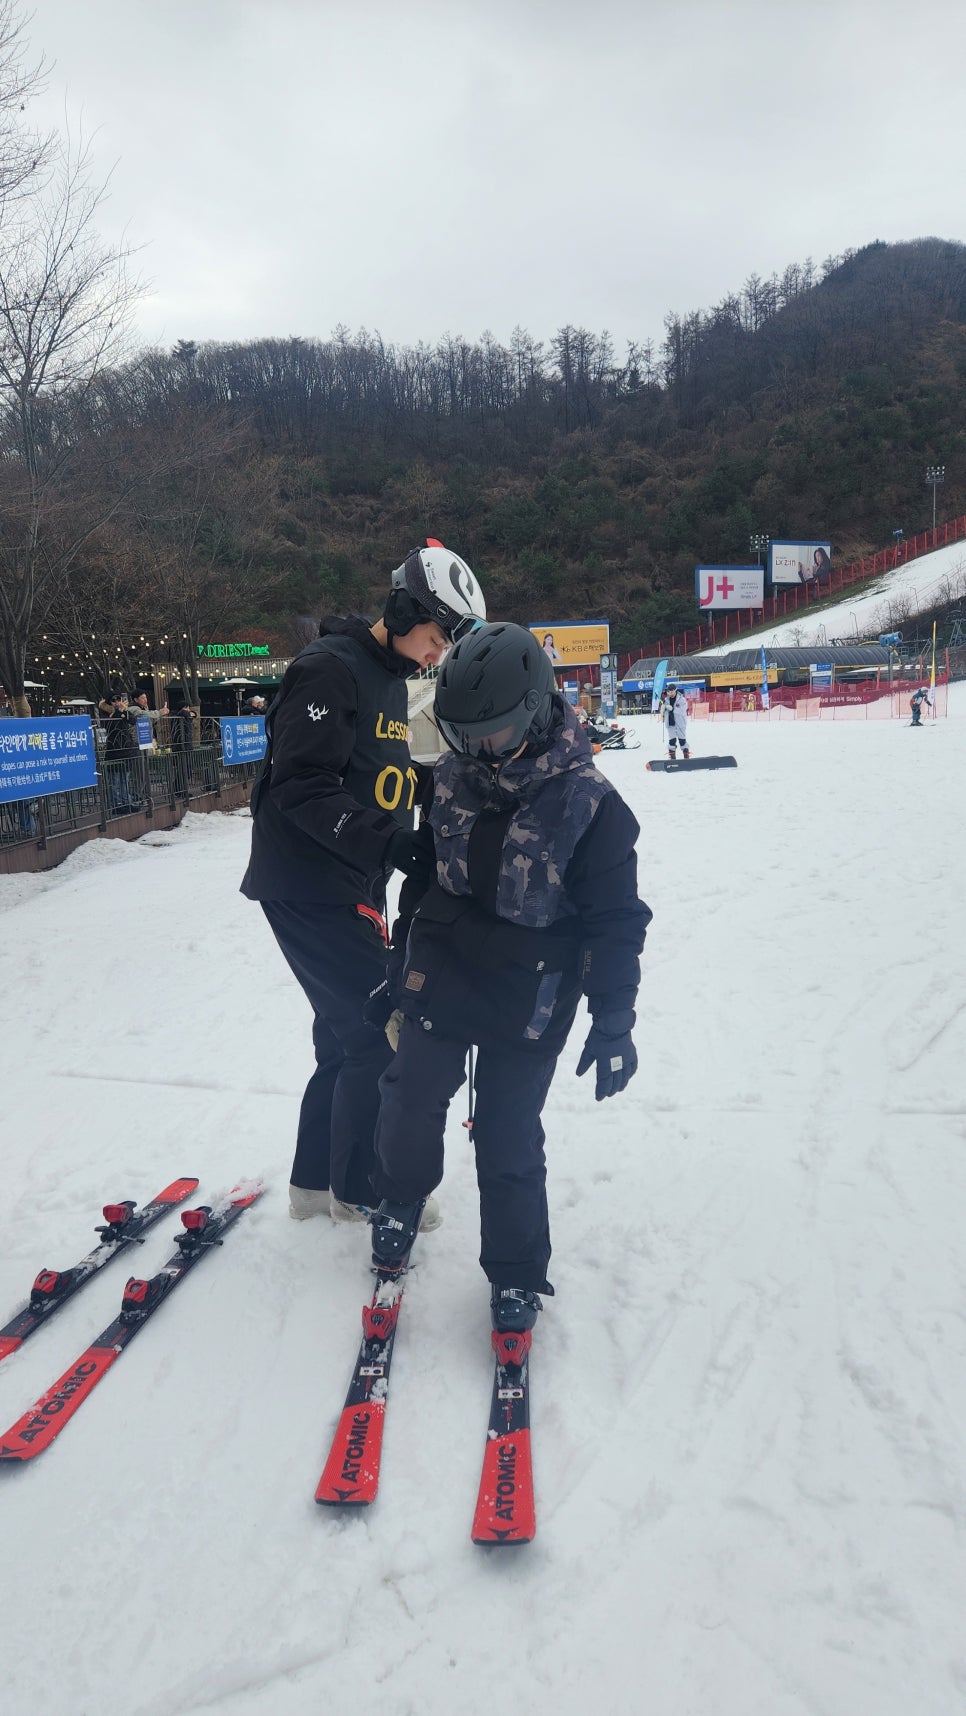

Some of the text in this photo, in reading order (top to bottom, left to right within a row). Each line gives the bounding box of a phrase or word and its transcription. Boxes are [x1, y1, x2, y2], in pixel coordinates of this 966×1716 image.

[1, 762, 16, 772] slopes
[25, 760, 36, 769] pose
[48, 757, 53, 765] to
[28, 732, 49, 751] 피해를
[49, 732, 57, 750] 줄
[57, 731, 64, 748] 수
[64, 730, 88, 748] 있습니다
[18, 1361, 97, 1443] ATOMIC
[341, 1412, 371, 1483] ATOMIC
[495, 1444, 517, 1521] ATOMIC
